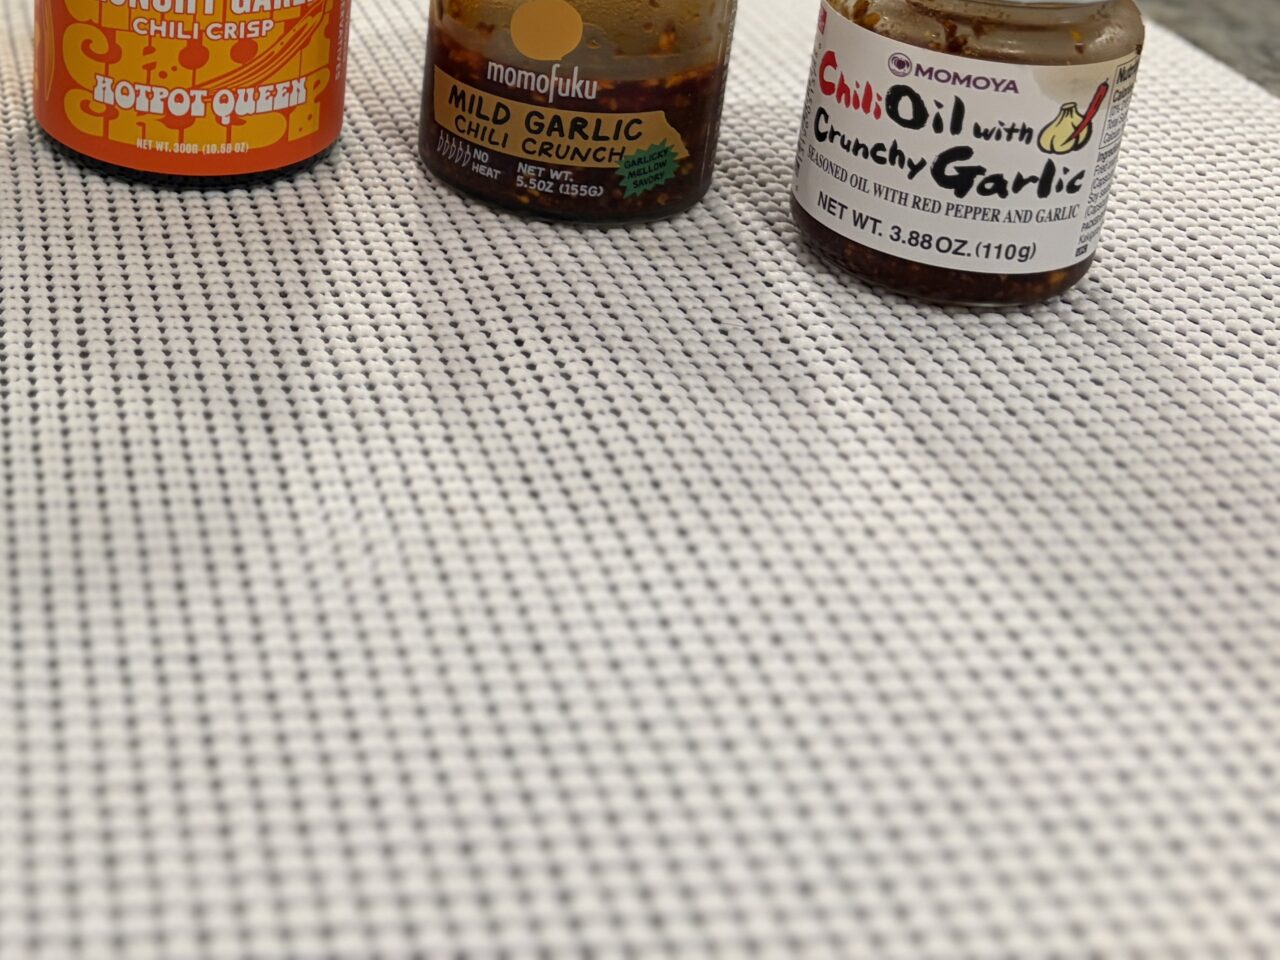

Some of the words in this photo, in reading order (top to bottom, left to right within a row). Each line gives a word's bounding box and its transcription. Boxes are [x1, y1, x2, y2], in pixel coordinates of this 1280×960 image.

[132, 17, 199, 40] CHILI
[205, 19, 275, 41] CRISP
[487, 60, 599, 104] momofuku
[914, 62, 1020, 95] MOMOYA
[93, 74, 208, 117] HOTPOT
[212, 77, 307, 125] QUEEN
[819, 50, 883, 120] Chili
[886, 84, 966, 136] Oil
[973, 120, 1034, 145] with
[448, 84, 511, 125] MILD
[524, 110, 643, 141] GARLIC
[136, 138, 154, 151] NET
[156, 140, 172, 153] WT.
[174, 141, 199, 155] 300G
[454, 113, 509, 149] CHILI
[521, 137, 627, 163] CRUNCH
[473, 149, 489, 163] NO
[624, 147, 669, 169] GARLICKY
[813, 106, 927, 180] Crunchy
[930, 145, 1086, 200] Garlic
[472, 162, 502, 180] HEAT
[517, 162, 546, 179] NET
[549, 167, 574, 182] WT.
[627, 159, 668, 179] MELLOW
[632, 170, 665, 189] SAVORY
[559, 182, 604, 197] (155G)
[807, 143, 848, 183] SEASONED
[849, 173, 870, 194] OIL
[873, 182, 909, 207] WITH
[912, 197, 942, 214] RED
[945, 204, 1001, 223] PEPPER
[1003, 209, 1033, 224] AND
[1035, 203, 1080, 224] GARLIC
[816, 190, 849, 220] NET
[851, 212, 883, 237] WT.
[975, 241, 1037, 263] (110g)
